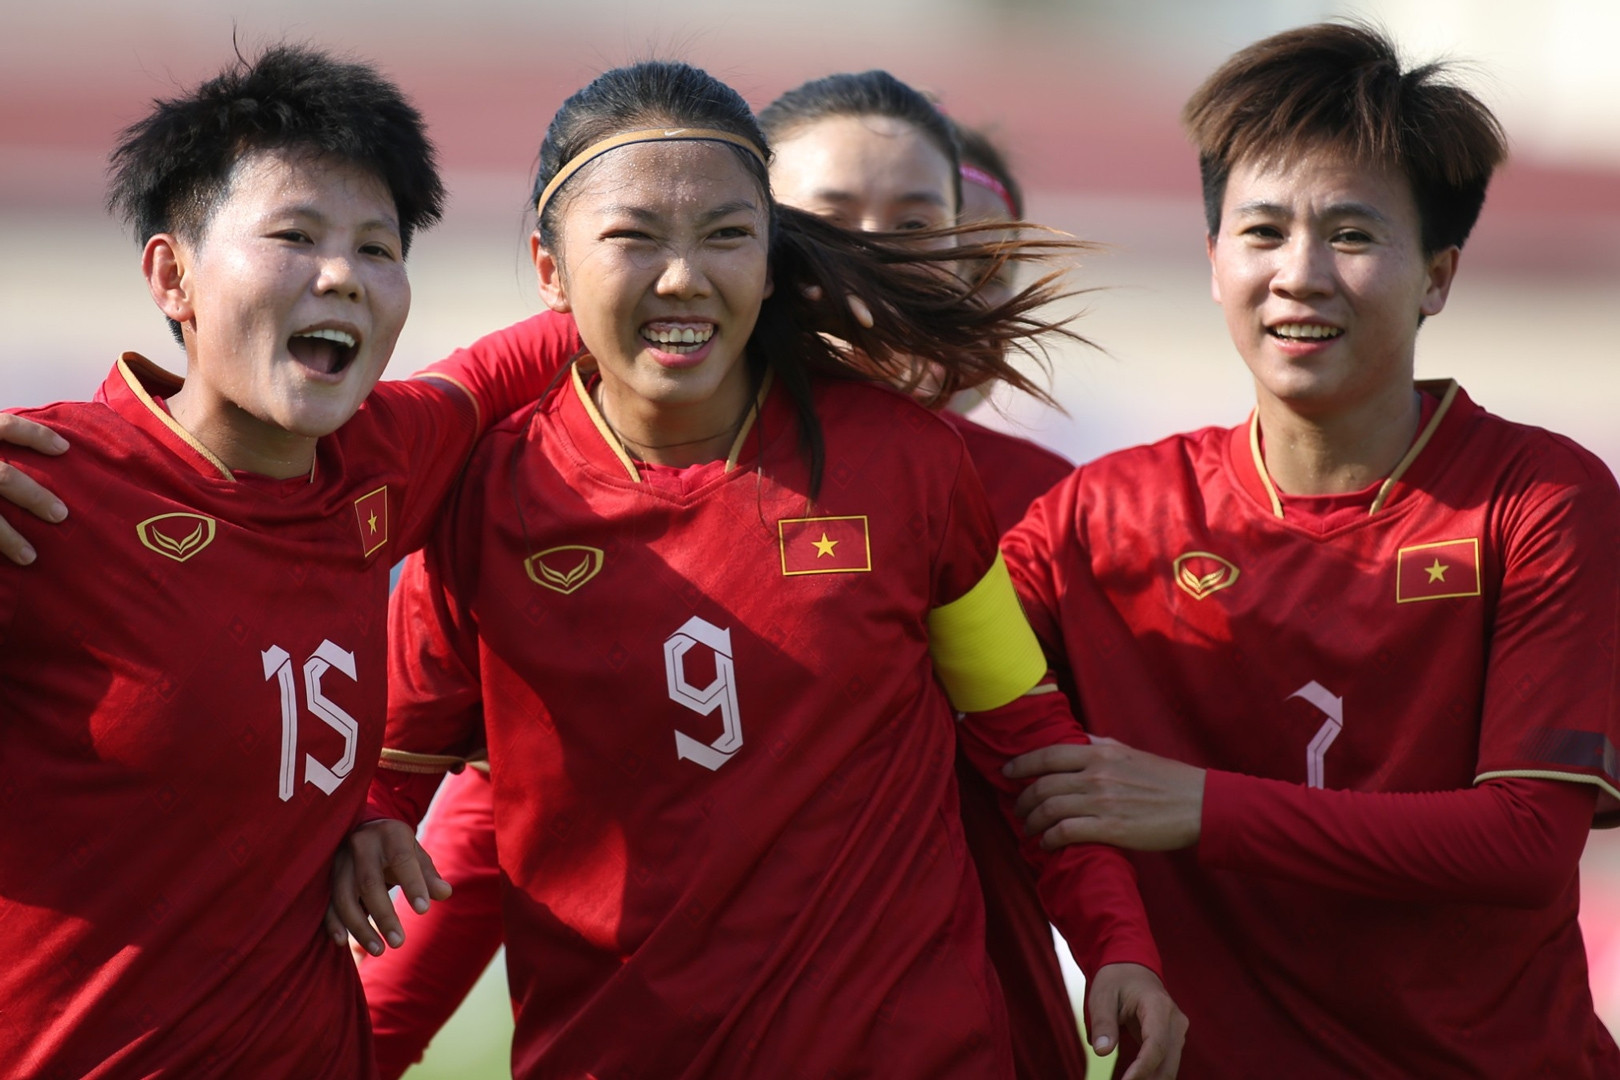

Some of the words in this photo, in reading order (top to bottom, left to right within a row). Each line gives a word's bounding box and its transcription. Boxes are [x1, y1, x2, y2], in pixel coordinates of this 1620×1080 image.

[261, 639, 358, 802] 15
[663, 615, 744, 772] 9
[1284, 680, 1343, 789] 7
